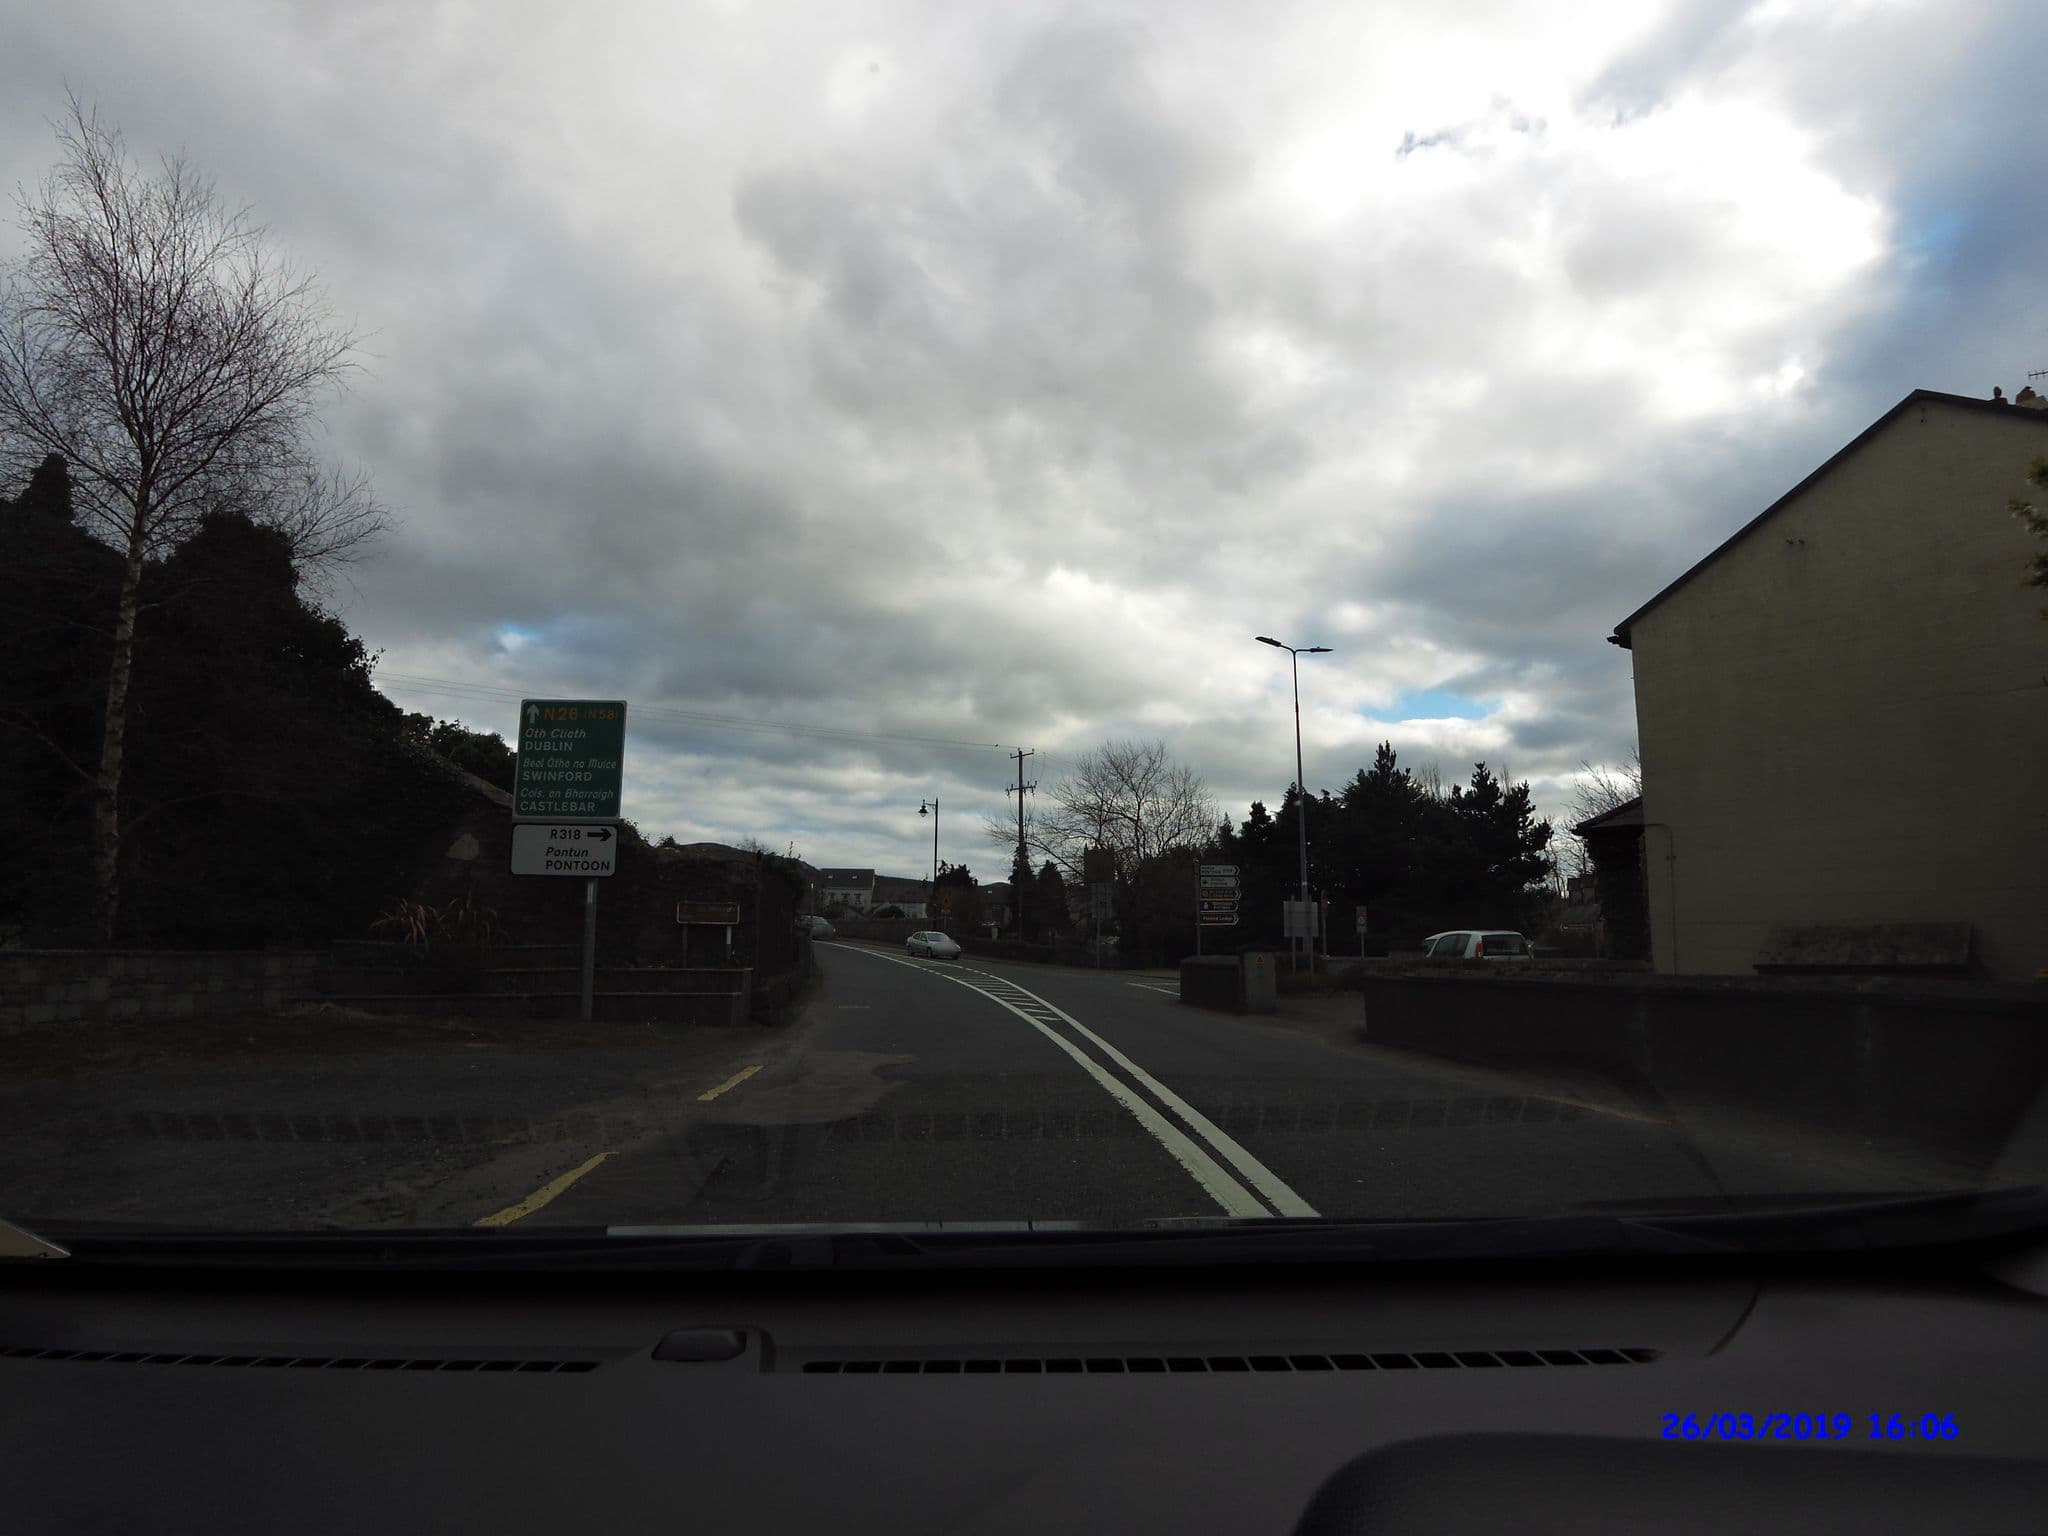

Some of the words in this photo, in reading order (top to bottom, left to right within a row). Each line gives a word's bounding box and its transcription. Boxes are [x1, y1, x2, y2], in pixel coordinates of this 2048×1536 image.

[525, 741, 573, 751] DUBLIN
[522, 771, 593, 782] SWINFORD
[549, 790, 562, 799] an
[520, 801, 596, 812] CASTLEBAR
[550, 829, 581, 839] R318
[545, 860, 610, 870] PONTOON
